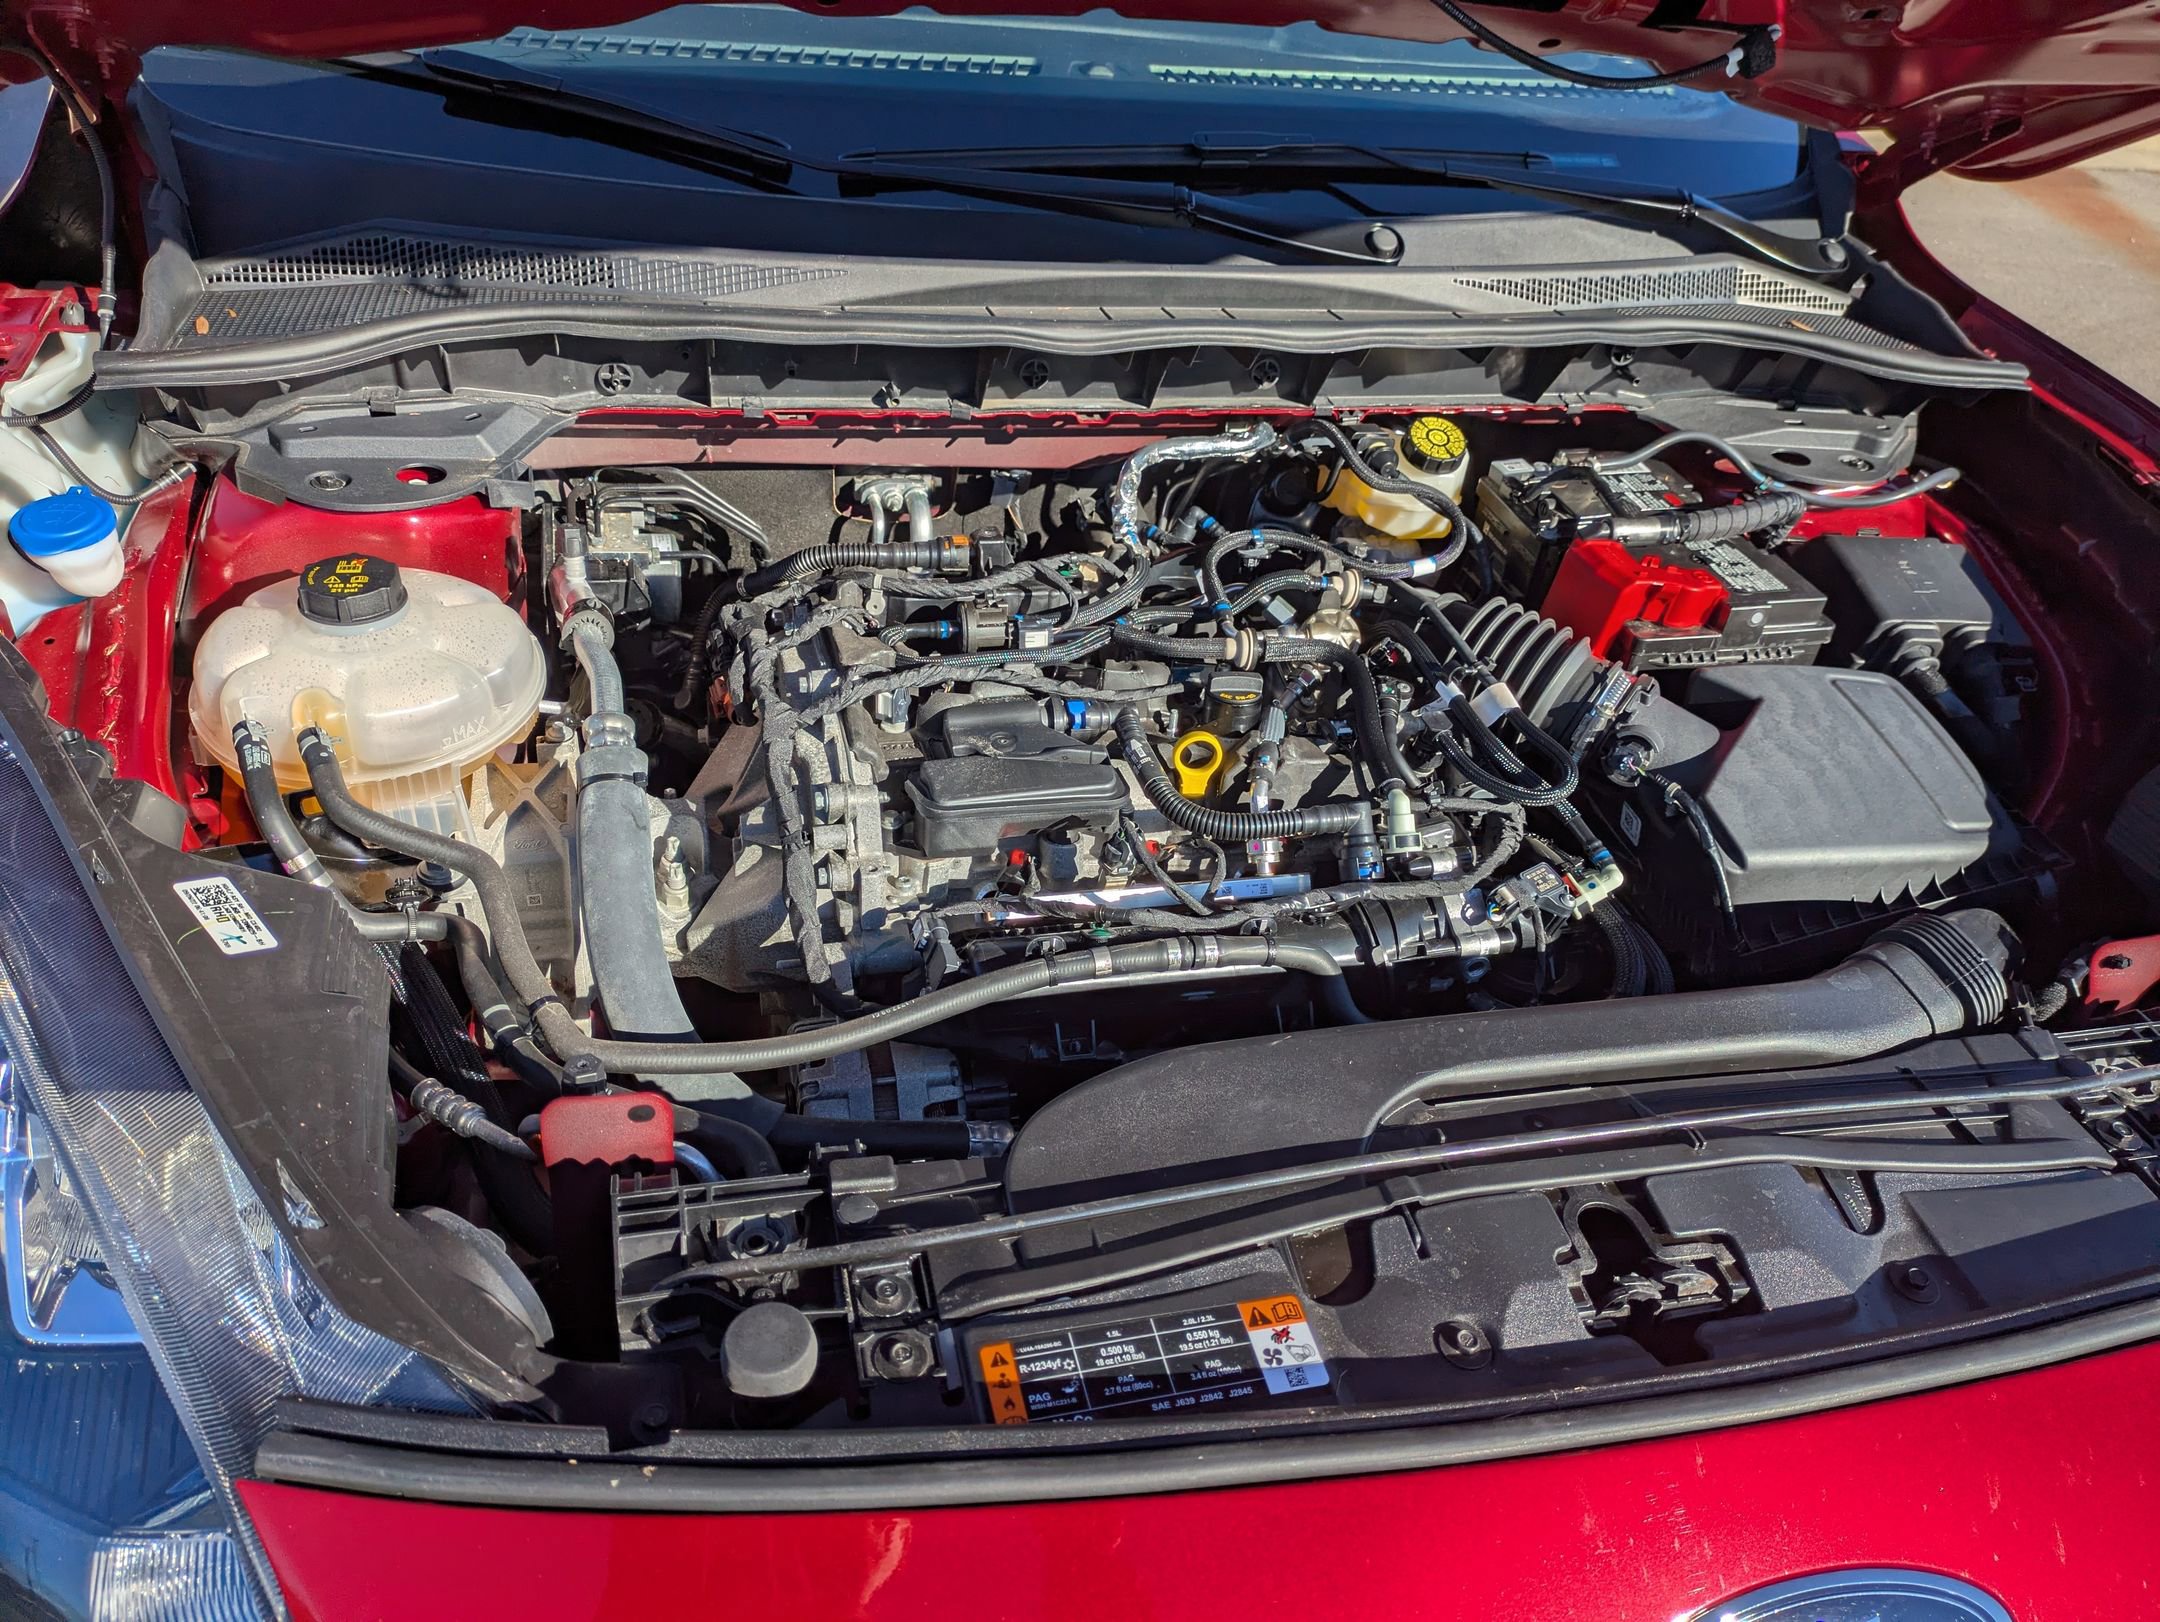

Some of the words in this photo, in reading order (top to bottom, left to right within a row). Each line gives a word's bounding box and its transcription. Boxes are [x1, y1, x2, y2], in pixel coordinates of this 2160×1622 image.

[452, 716, 490, 742] MAX
[1200, 1314, 1216, 1323] 2.3L
[1106, 1330, 1122, 1338] 1.5L
[1186, 1330, 1208, 1342] 0.550
[1208, 1329, 1220, 1339] kg
[1179, 1342, 1194, 1352] 19.5
[1219, 1335, 1234, 1345] lbs)
[1100, 1345, 1123, 1357] 0.500
[1122, 1344, 1135, 1354] kg
[1131, 1351, 1146, 1361] lbs)
[1019, 1358, 1062, 1374] R-1234yf
[1204, 1359, 1222, 1369] PAG
[1117, 1373, 1135, 1383] PAG
[1103, 1386, 1115, 1396] 2.7
[1122, 1385, 1132, 1393] oz
[1028, 1392, 1051, 1404] PAG
[1151, 1401, 1171, 1411] SAE
[1175, 1397, 1196, 1407] J639
[1199, 1391, 1224, 1403] J2842
[1228, 1386, 1253, 1398] J2845
